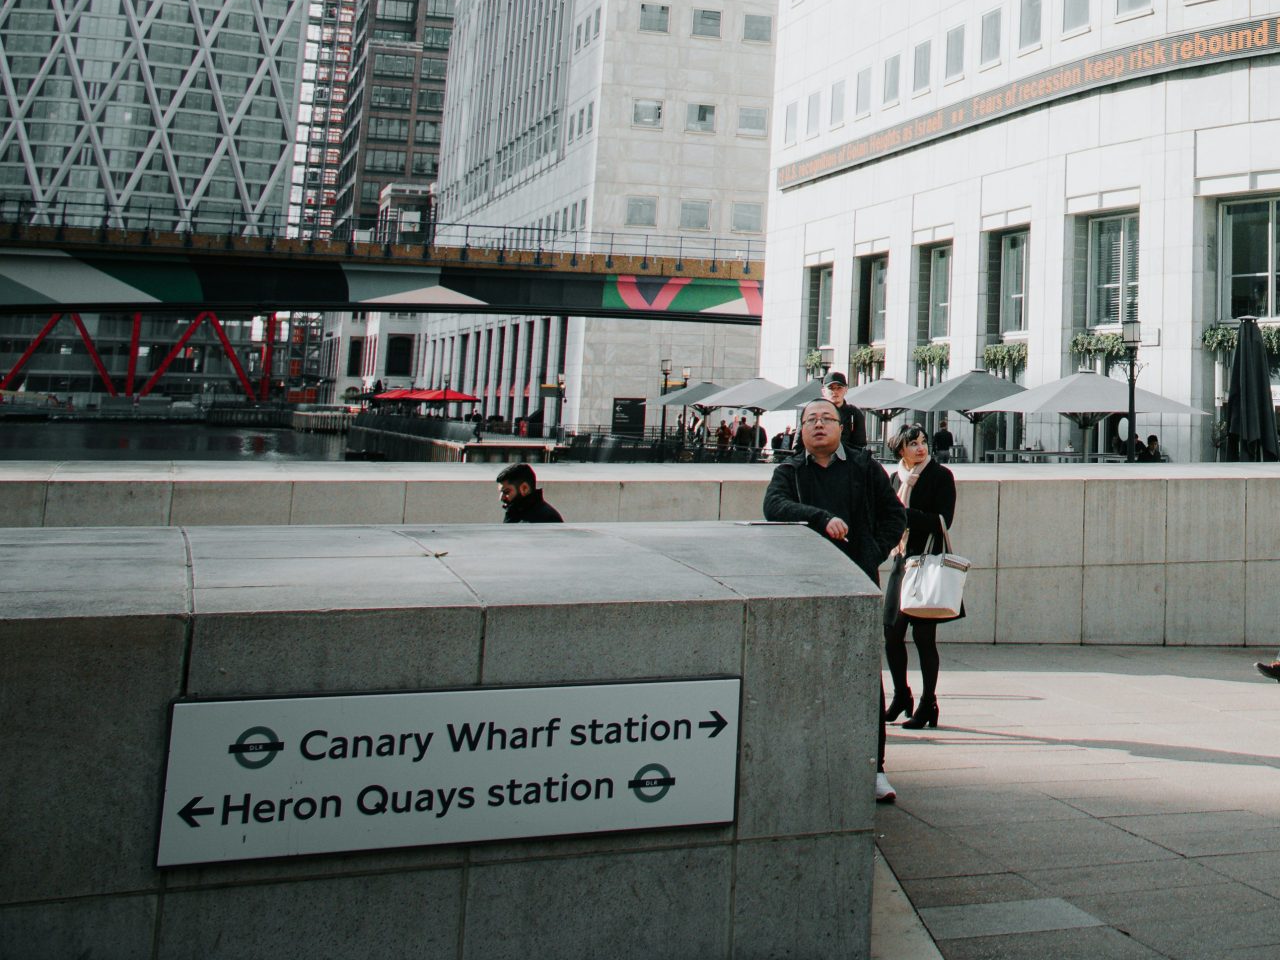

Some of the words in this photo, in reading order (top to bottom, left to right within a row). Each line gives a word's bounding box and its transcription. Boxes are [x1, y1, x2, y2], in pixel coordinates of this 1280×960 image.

[972, 91, 1003, 118] Fears
[1006, 82, 1017, 106] of
[1019, 64, 1081, 101] recession
[1084, 54, 1125, 81] keep
[1129, 40, 1166, 70] risk
[1171, 20, 1270, 62] rebound
[915, 110, 943, 138] Israeli
[300, 729, 434, 763] Canary
[447, 718, 561, 750] Wharf
[570, 714, 693, 746] station
[220, 793, 342, 825] Heron
[356, 783, 475, 822] Quays
[487, 773, 613, 806] station
